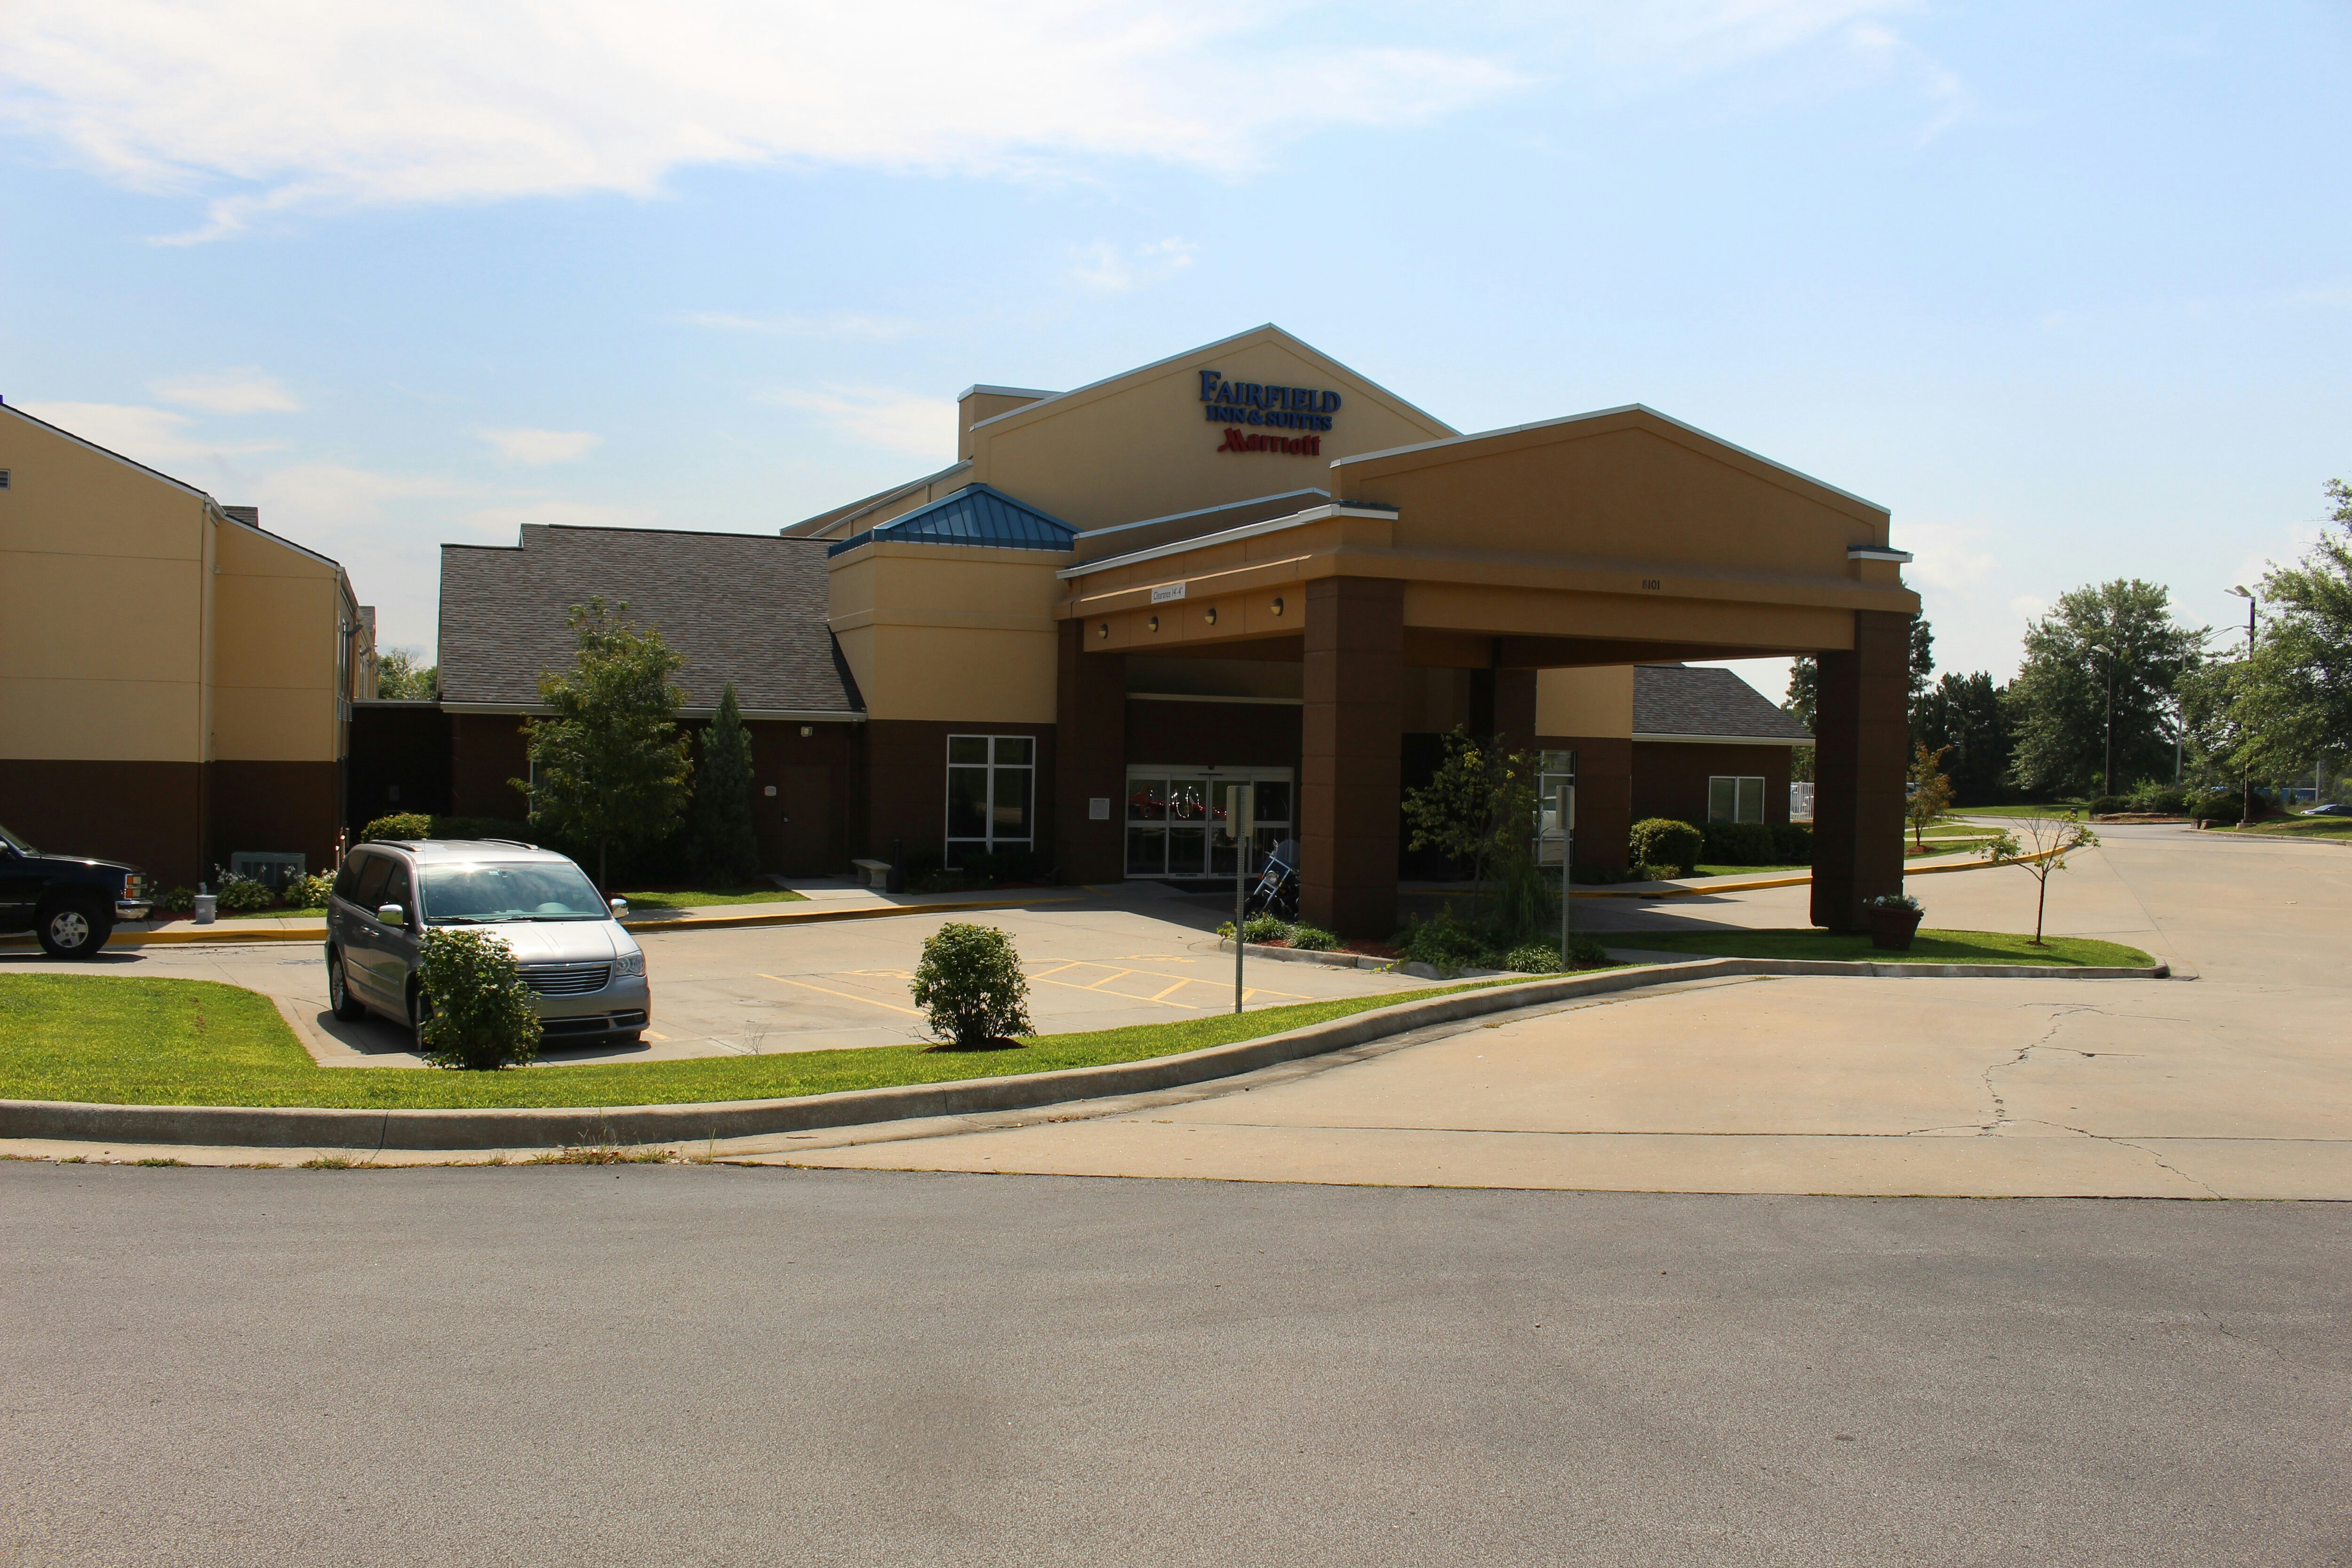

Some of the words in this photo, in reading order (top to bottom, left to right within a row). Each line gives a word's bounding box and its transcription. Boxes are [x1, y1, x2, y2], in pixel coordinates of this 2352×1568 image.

[1199, 370, 1341, 413] FAIRFIELD
[1206, 405, 1246, 423] INN
[1247, 409, 1265, 425] &
[1265, 411, 1332, 431] SUITES
[1217, 427, 1321, 455] Marriott
[1153, 591, 1171, 600] Clearance
[1642, 579, 1660, 590] 8101
